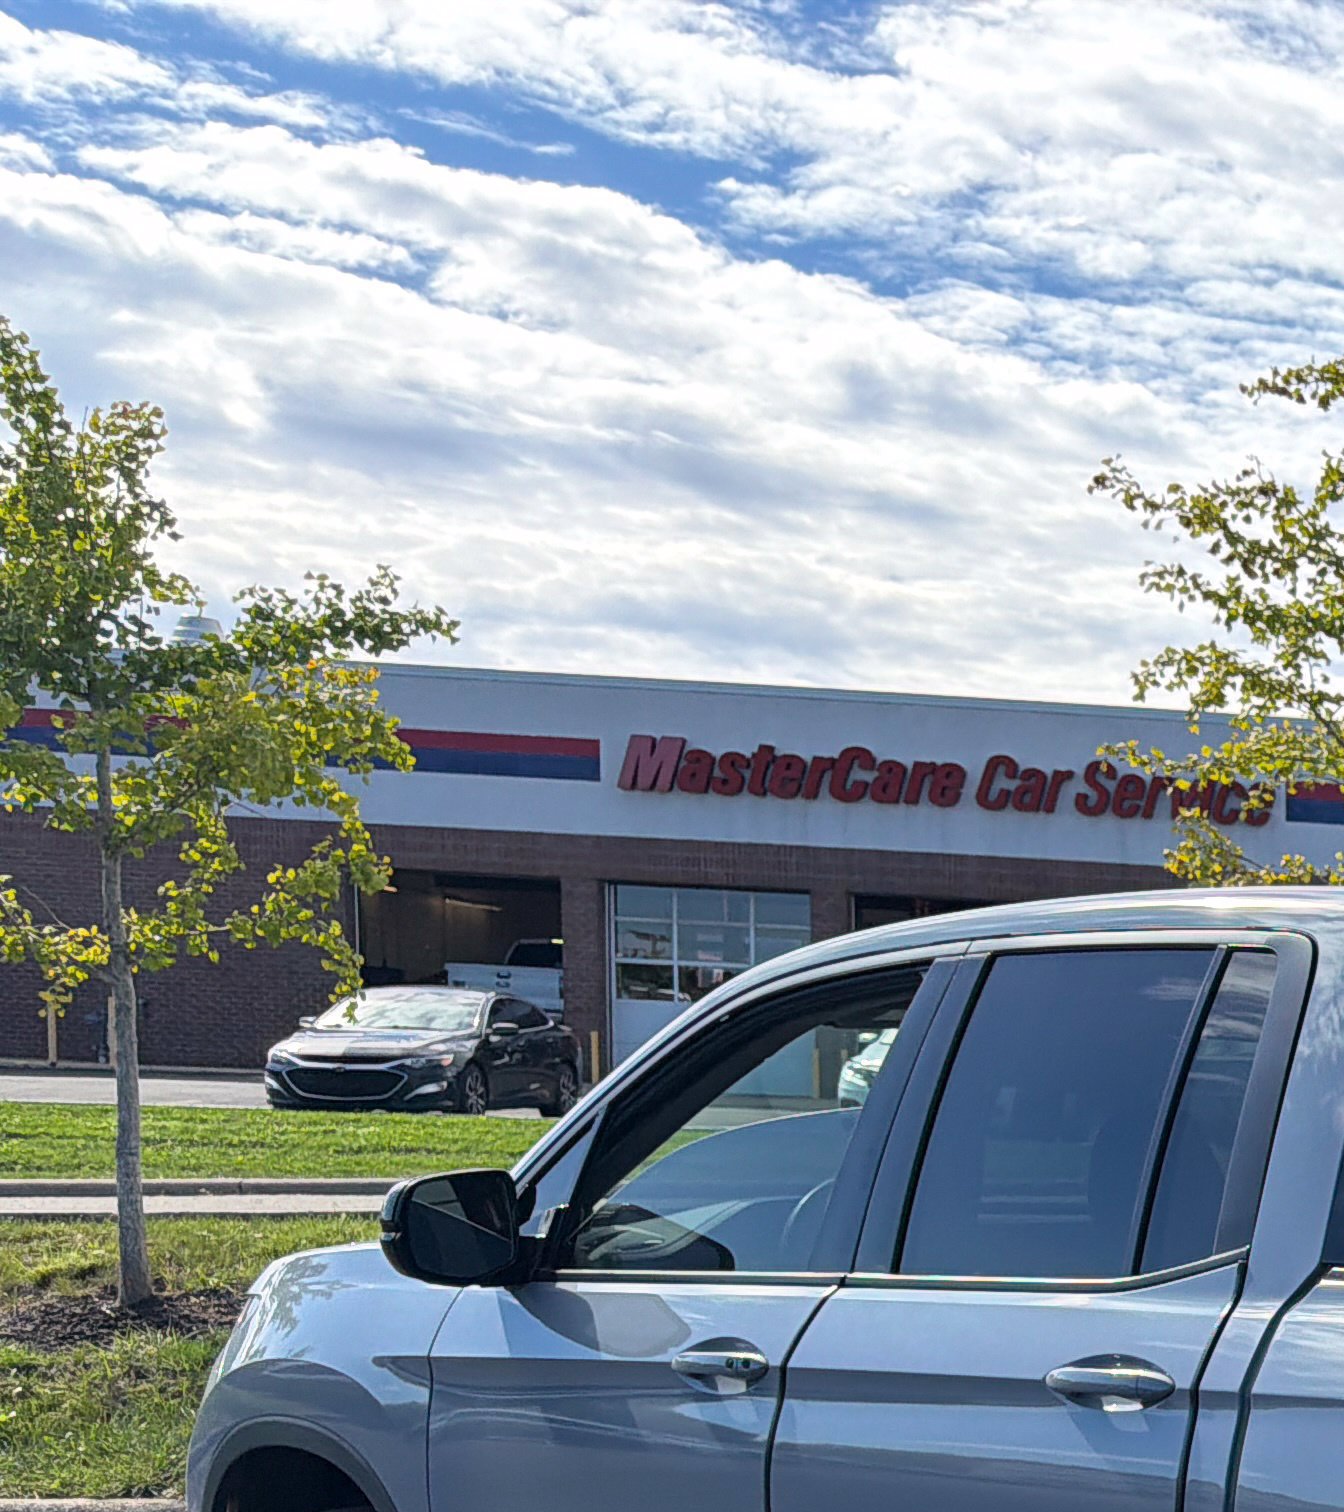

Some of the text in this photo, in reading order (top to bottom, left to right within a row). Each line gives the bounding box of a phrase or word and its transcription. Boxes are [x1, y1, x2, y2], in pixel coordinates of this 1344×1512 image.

[616, 734, 1276, 826] MasterCare Car Service
